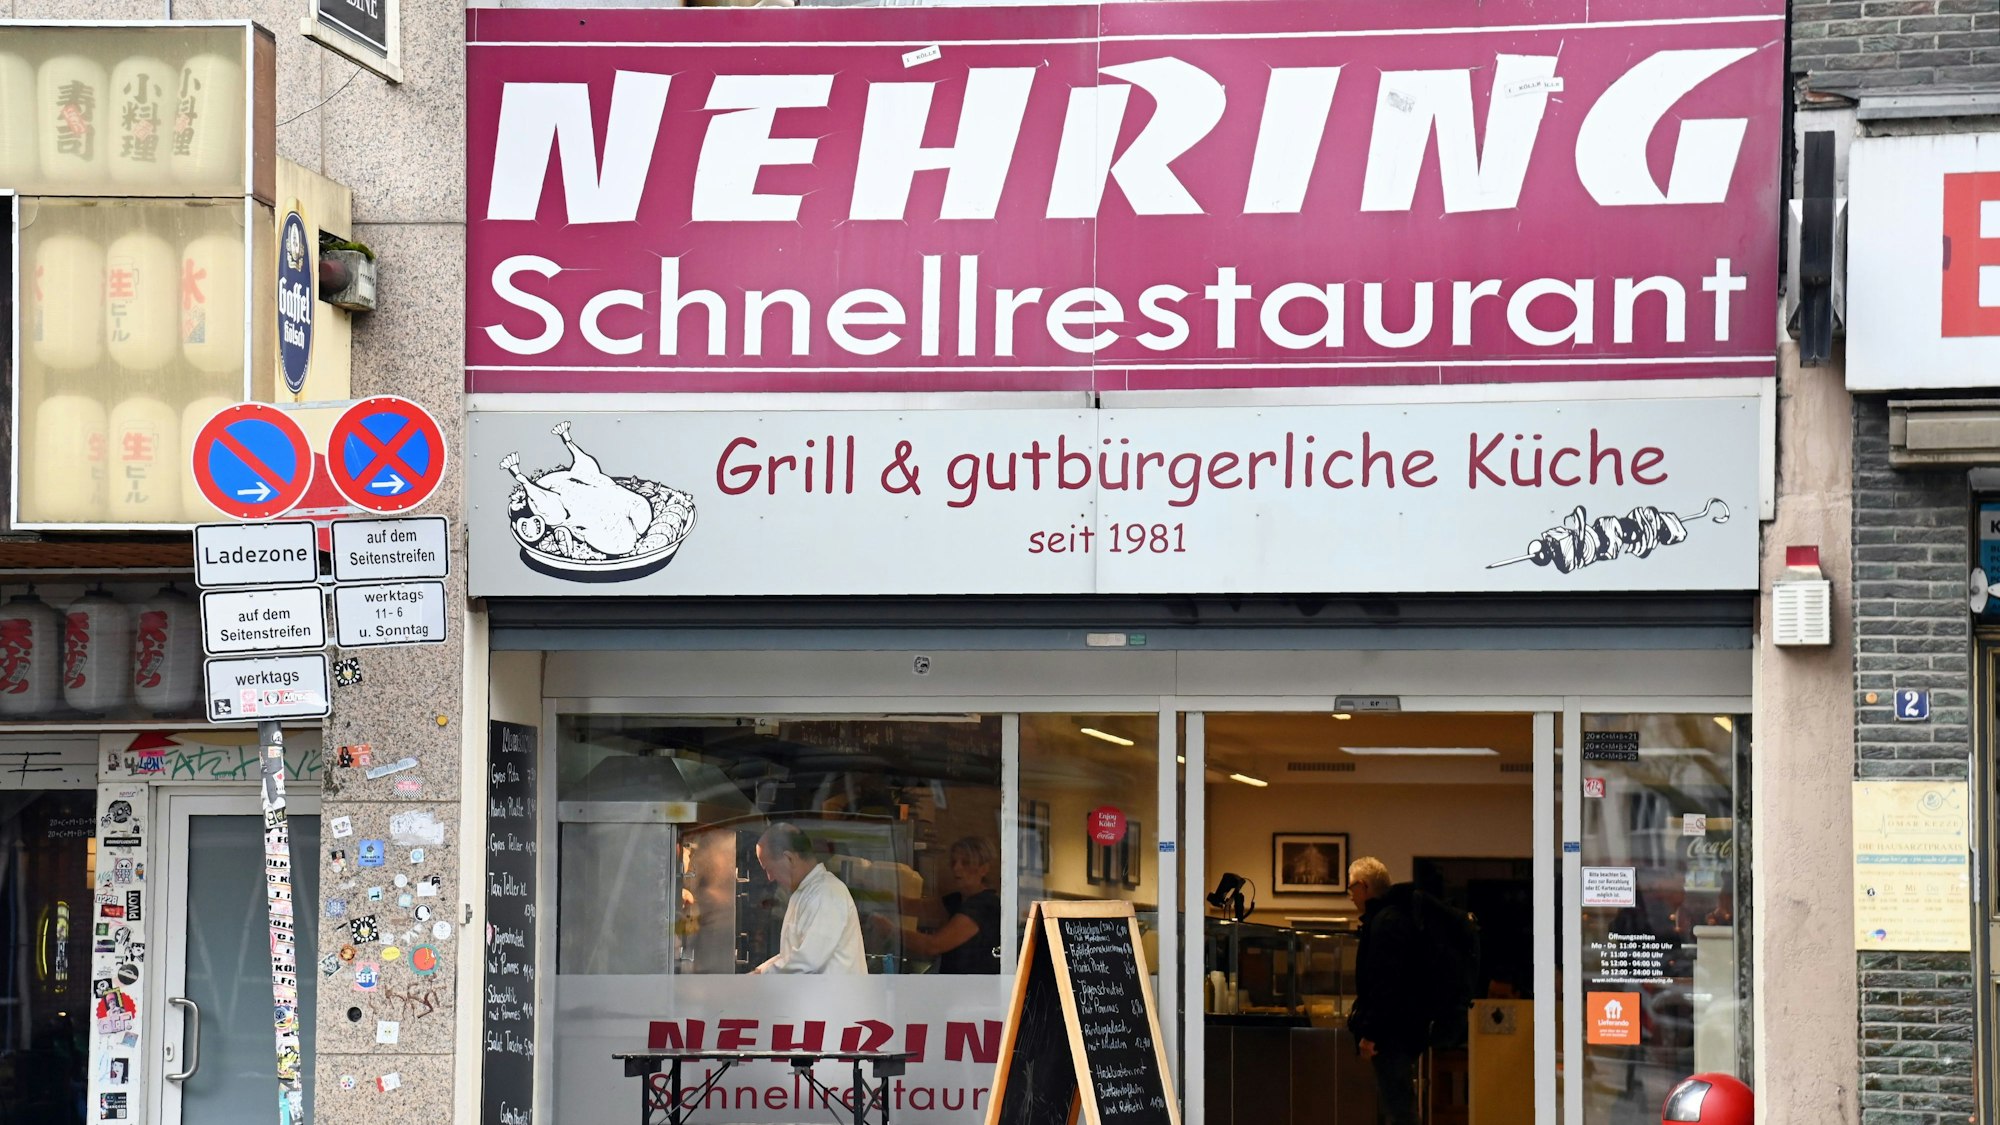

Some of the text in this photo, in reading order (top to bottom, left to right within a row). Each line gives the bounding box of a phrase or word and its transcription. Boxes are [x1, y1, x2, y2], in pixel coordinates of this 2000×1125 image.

[120, 73, 162, 163] 小料理
[486, 47, 1757, 225] NEHRING
[278, 277, 311, 325] Gaffel
[485, 257, 1746, 356] Schnellrestaurant
[284, 320, 304, 349] Kölsch
[122, 431, 153, 503] 生ビール
[716, 428, 1668, 508] Grill & gutbürgerliche Küche
[367, 529, 417, 544] auf dem
[1028, 523, 1187, 554] seit 1981
[205, 546, 308, 565] Ladezone
[350, 548, 435, 566] Seitenstreifen
[364, 588, 424, 604] werktags
[238, 608, 290, 623] auf dem
[220, 624, 311, 642] Seitenstreifen
[359, 623, 429, 639] u. Sonntag
[235, 669, 299, 686] werktags
[1904, 690, 1919, 717] 2
[491, 763, 506, 789] Gyros
[1098, 812, 1117, 820] Enjoy
[490, 833, 505, 857] Gyros
[508, 833, 523, 852] Teller
[489, 872, 502, 897] Taxi
[502, 872, 519, 896] Teller
[128, 892, 140, 920] PIVOT
[1608, 932, 1655, 941] Öffnungszeiten
[488, 957, 498, 974] mit
[500, 952, 520, 975] Pommes
[488, 984, 518, 1004] Schaschlik
[488, 1007, 499, 1021] mit
[501, 1004, 521, 1021] Pommes
[1597, 1019, 1629, 1027] Lieferando
[487, 1030, 503, 1052] Salat
[504, 1030, 523, 1056] Tasche
[647, 1018, 1004, 1064] NEHRIN
[648, 1069, 989, 1110] Schnellrestaur
